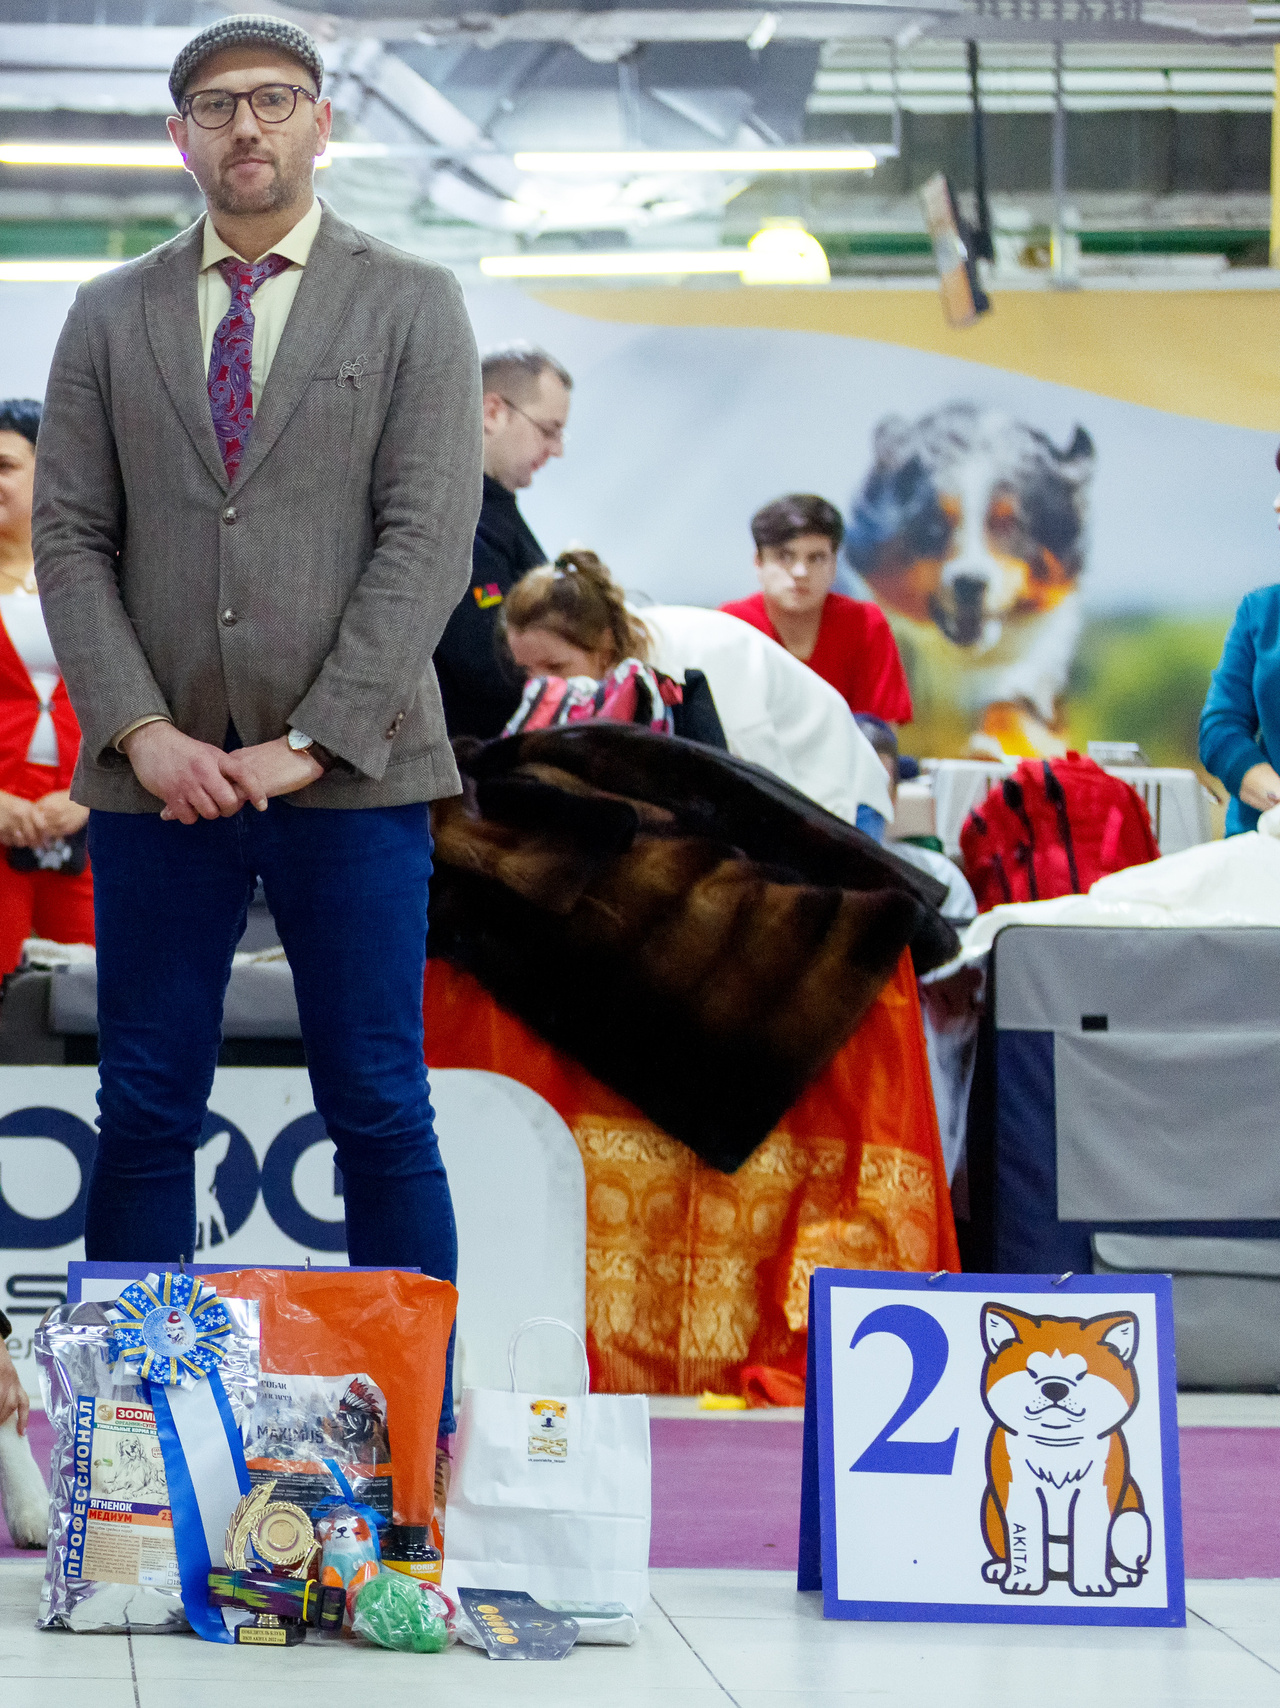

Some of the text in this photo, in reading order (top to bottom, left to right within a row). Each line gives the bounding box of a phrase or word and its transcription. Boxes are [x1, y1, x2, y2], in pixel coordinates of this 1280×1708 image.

[848, 1303, 960, 1476] 2
[66, 1401, 93, 1576] ПРОФЕССИОНАЛ
[88, 1509, 133, 1523] МЕДИУМ
[89, 1498, 133, 1512] ЯГНЕНОК
[1011, 1522, 1028, 1577] AKITA
